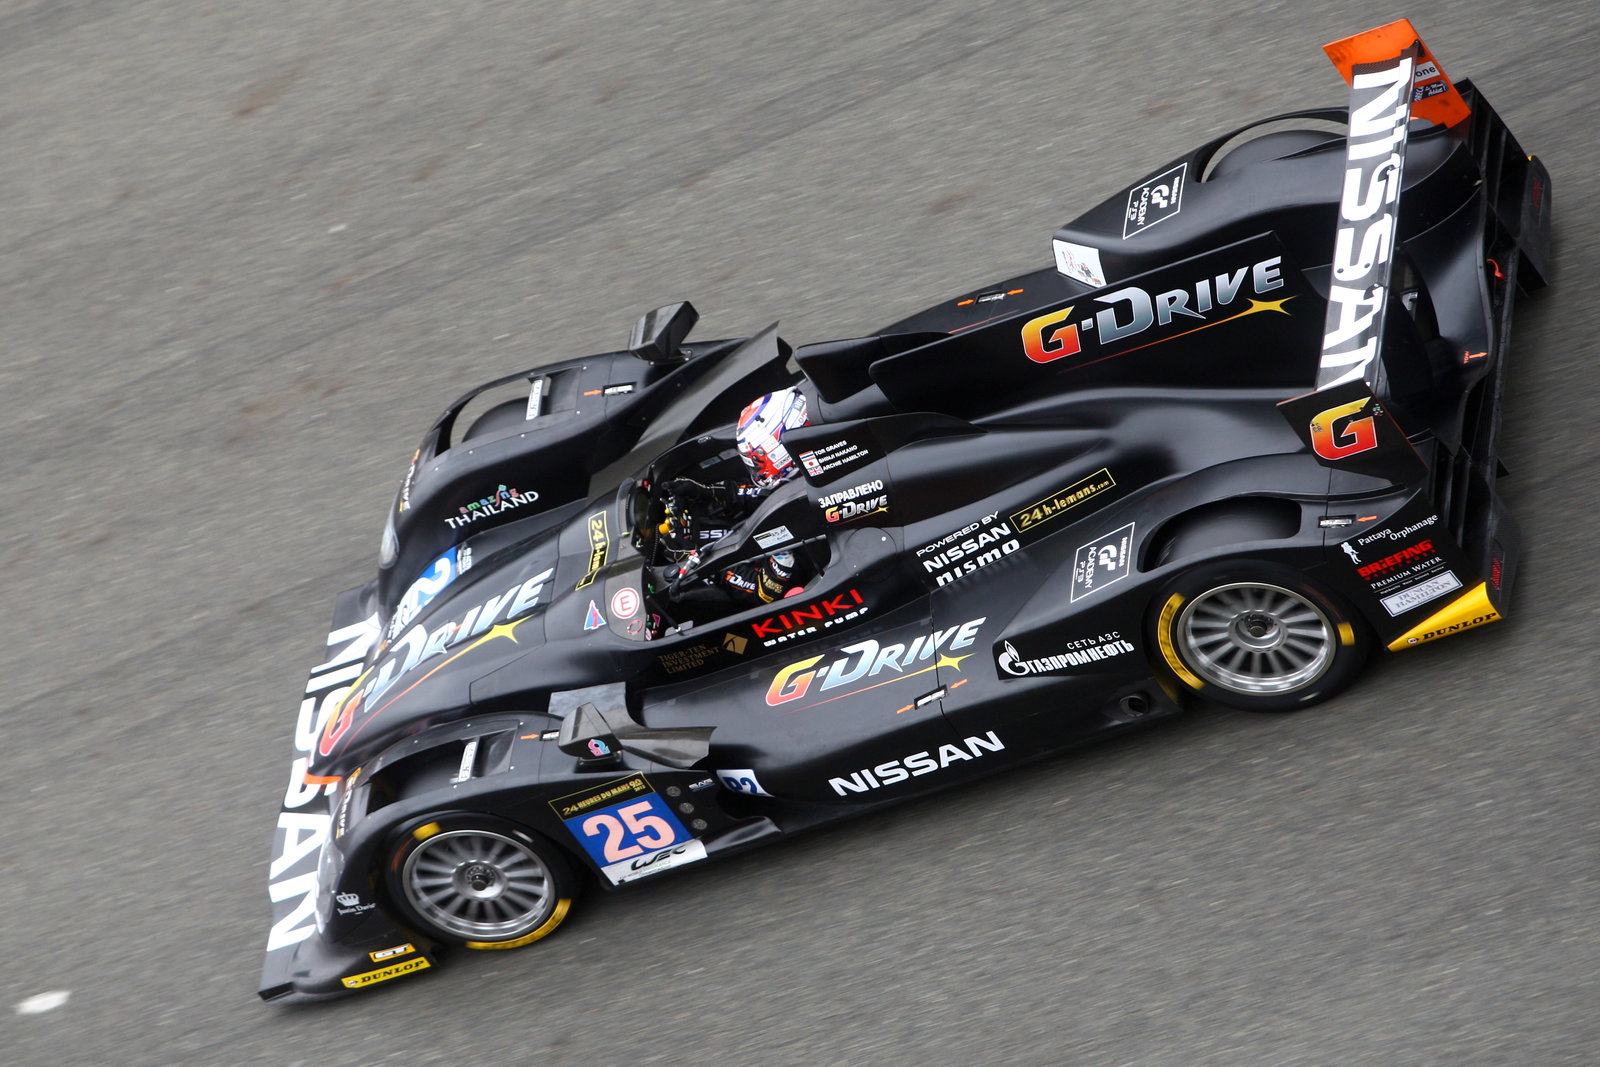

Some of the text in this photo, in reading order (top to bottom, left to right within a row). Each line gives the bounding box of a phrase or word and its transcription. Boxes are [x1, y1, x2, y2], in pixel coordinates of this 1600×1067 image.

[1137, 187, 1150, 226] ACADEMY
[1021, 256, 1285, 364] G-DRIVE
[1310, 396, 1378, 461] G
[814, 440, 848, 456] TOR GRAVES
[822, 449, 869, 471] ARCHIE HAMILTON
[835, 445, 858, 458] NAKANO
[444, 490, 540, 529] THAILAND
[458, 484, 521, 514] amazing
[818, 479, 884, 508] ЗАПРАВЛЕНО
[916, 511, 999, 557] POWERED BY
[1357, 514, 1439, 546] Pattaya Orphanage
[922, 522, 1012, 573] NISSAN
[936, 538, 1020, 587] nismo
[1119, 536, 1128, 568] NISSAN
[1357, 539, 1434, 577] BRIEFING
[1085, 547, 1097, 589] ACADEMY
[1370, 570, 1411, 590] PREMIUM
[1411, 556, 1443, 572] WATER
[1395, 581, 1452, 608] HAMILTON
[1399, 580, 1440, 600] DUNCAN
[751, 589, 865, 639] KINKI
[763, 607, 869, 647] WATER PUMP
[1422, 613, 1497, 641] DUNLOP
[658, 643, 707, 661] TIGER-TEN
[662, 646, 720, 668] INVESTMENT
[1026, 639, 1135, 674] ГАЗПРОМНЕФТЬ
[1067, 631, 1121, 650] СЕТЬ АЗС
[666, 659, 705, 675] LIMITED
[765, 616, 987, 707] G-DRIVE
[828, 730, 1006, 797] NISSAN
[562, 804, 579, 816] 24
[577, 795, 602, 808] HEURES
[600, 790, 612, 799] DU
[610, 783, 631, 795] MANS
[581, 800, 676, 864] 25
[631, 844, 687, 871] WEC
[361, 958, 425, 984] DUNLOP
